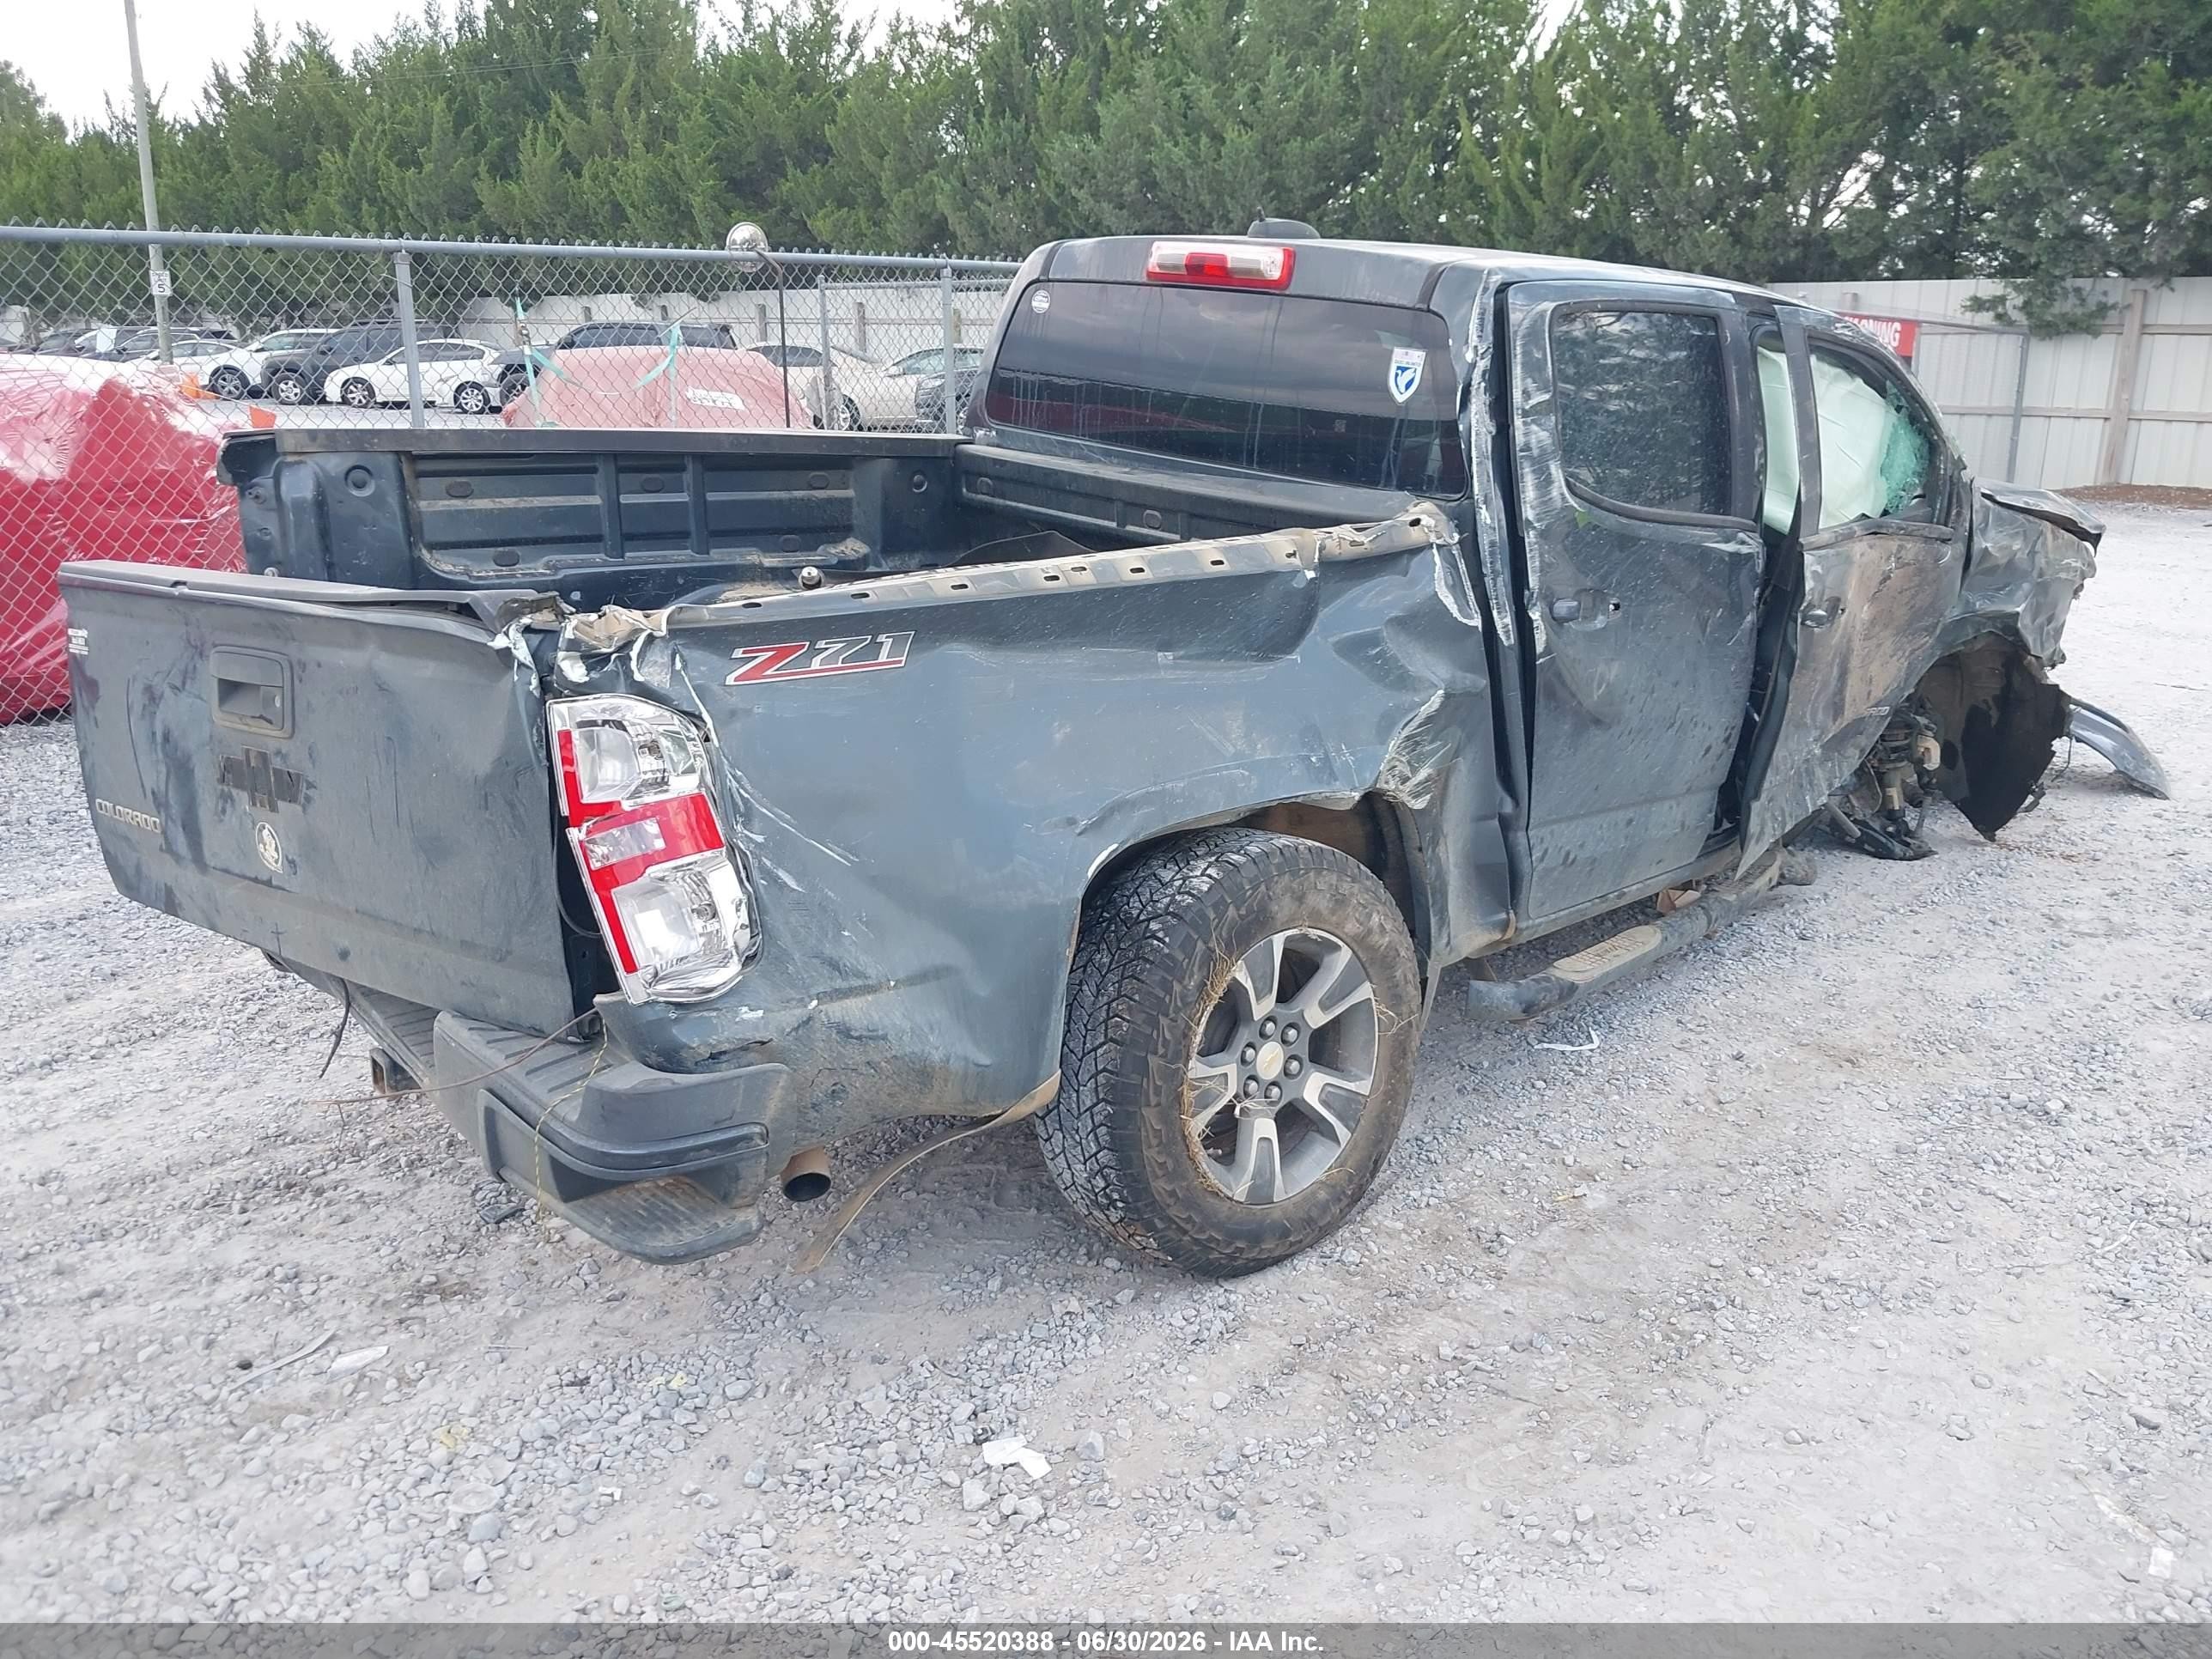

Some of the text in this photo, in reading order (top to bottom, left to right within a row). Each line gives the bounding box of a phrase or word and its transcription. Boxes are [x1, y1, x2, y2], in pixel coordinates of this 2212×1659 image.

[157, 283, 166, 293] 5
[1844, 317, 1901, 348] NING
[725, 630, 917, 685] Z71
[95, 799, 161, 833] COLORADO
